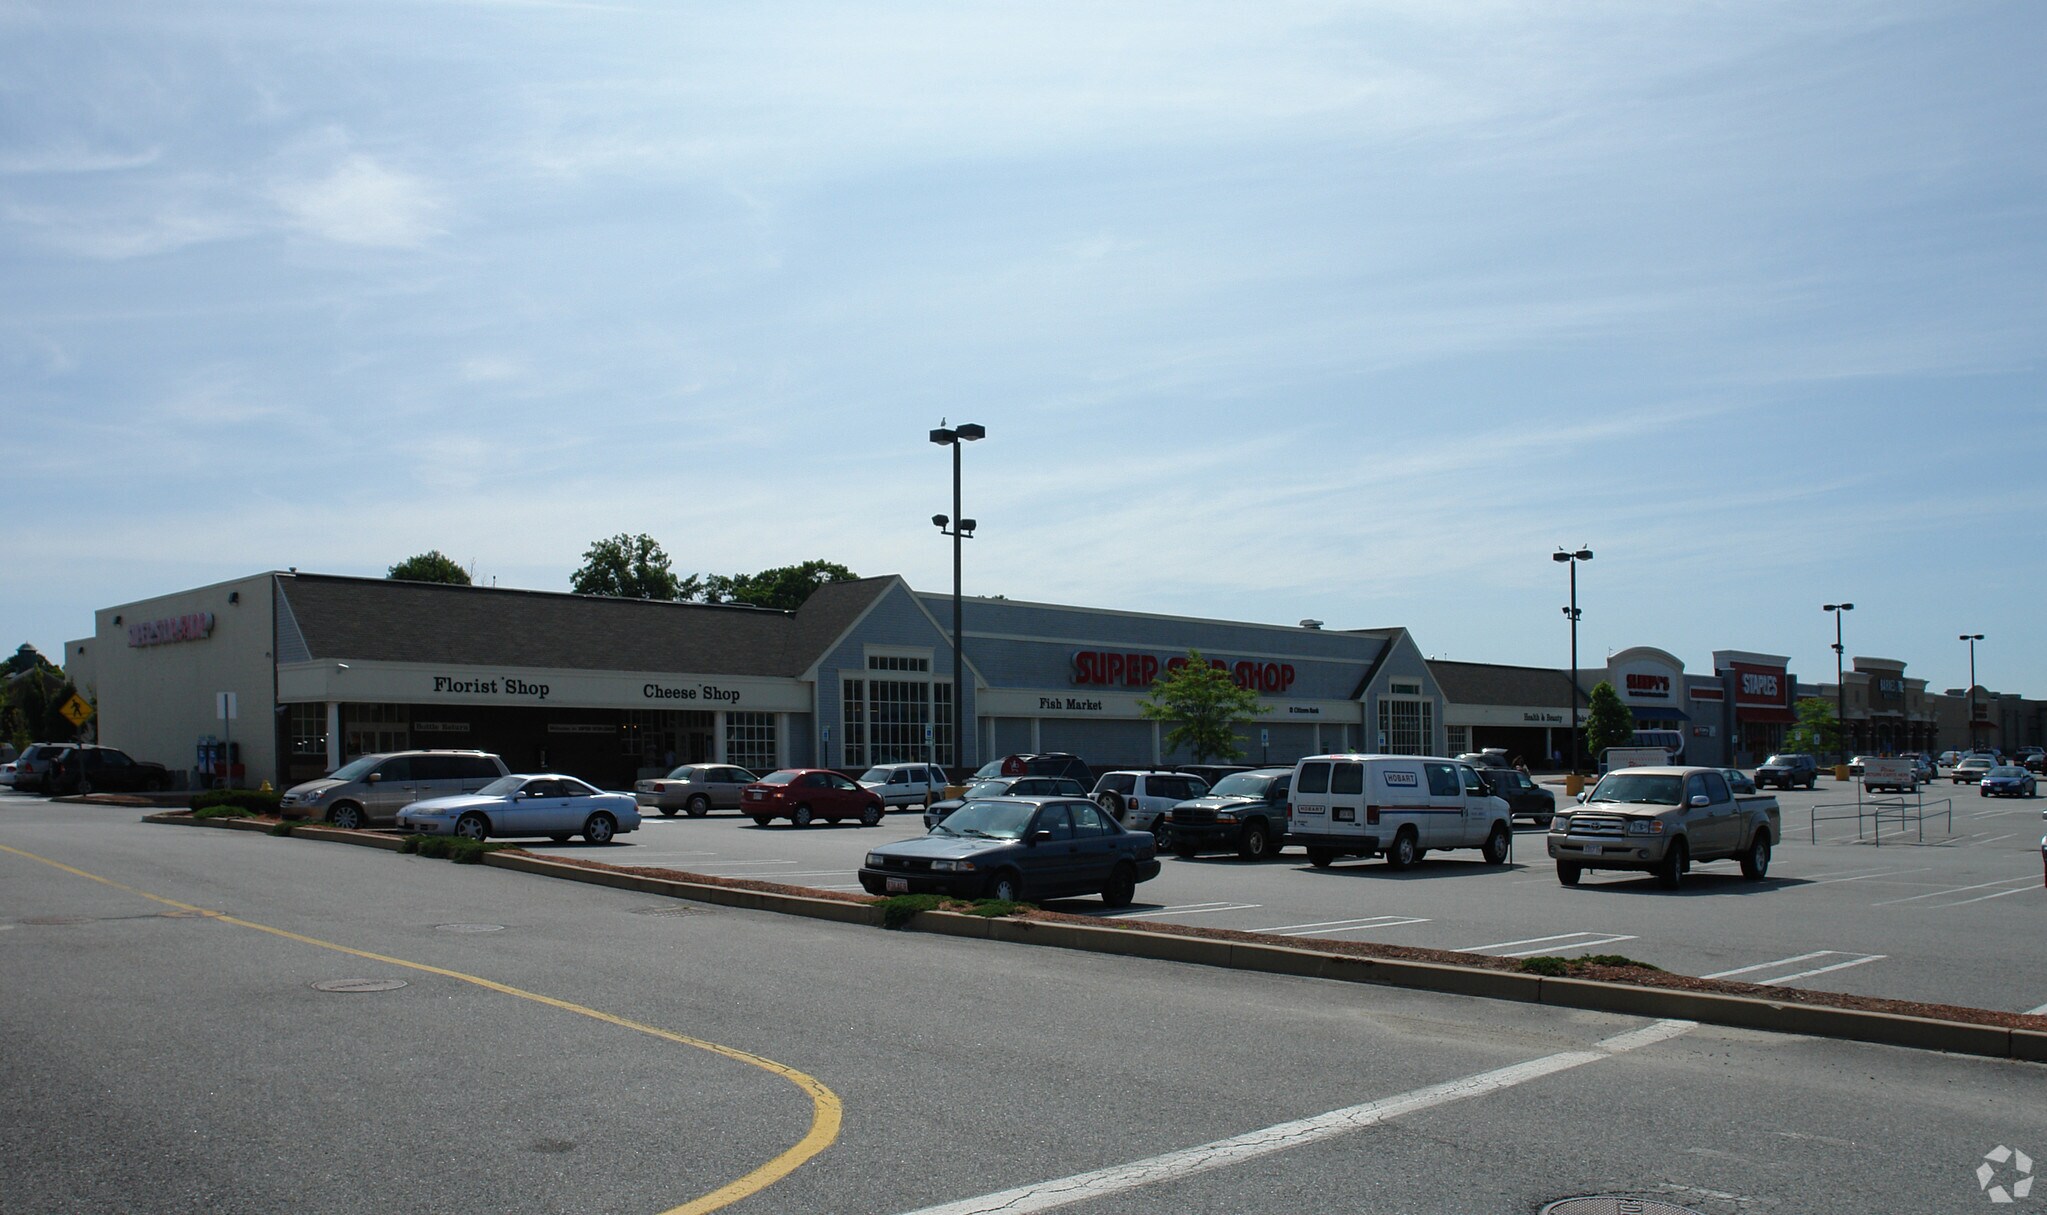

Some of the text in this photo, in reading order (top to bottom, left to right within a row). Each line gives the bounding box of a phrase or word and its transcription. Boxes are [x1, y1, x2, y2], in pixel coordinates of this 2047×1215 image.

[1073, 651, 1159, 687] SUPER
[1233, 660, 1295, 691] SHOP
[433, 676, 550, 699] Florist Shop
[643, 683, 740, 704] Cheese Shop
[1743, 673, 1778, 697] STAPLES
[1039, 697, 1102, 710] Fish Market
[1387, 774, 1415, 783] HOBART
